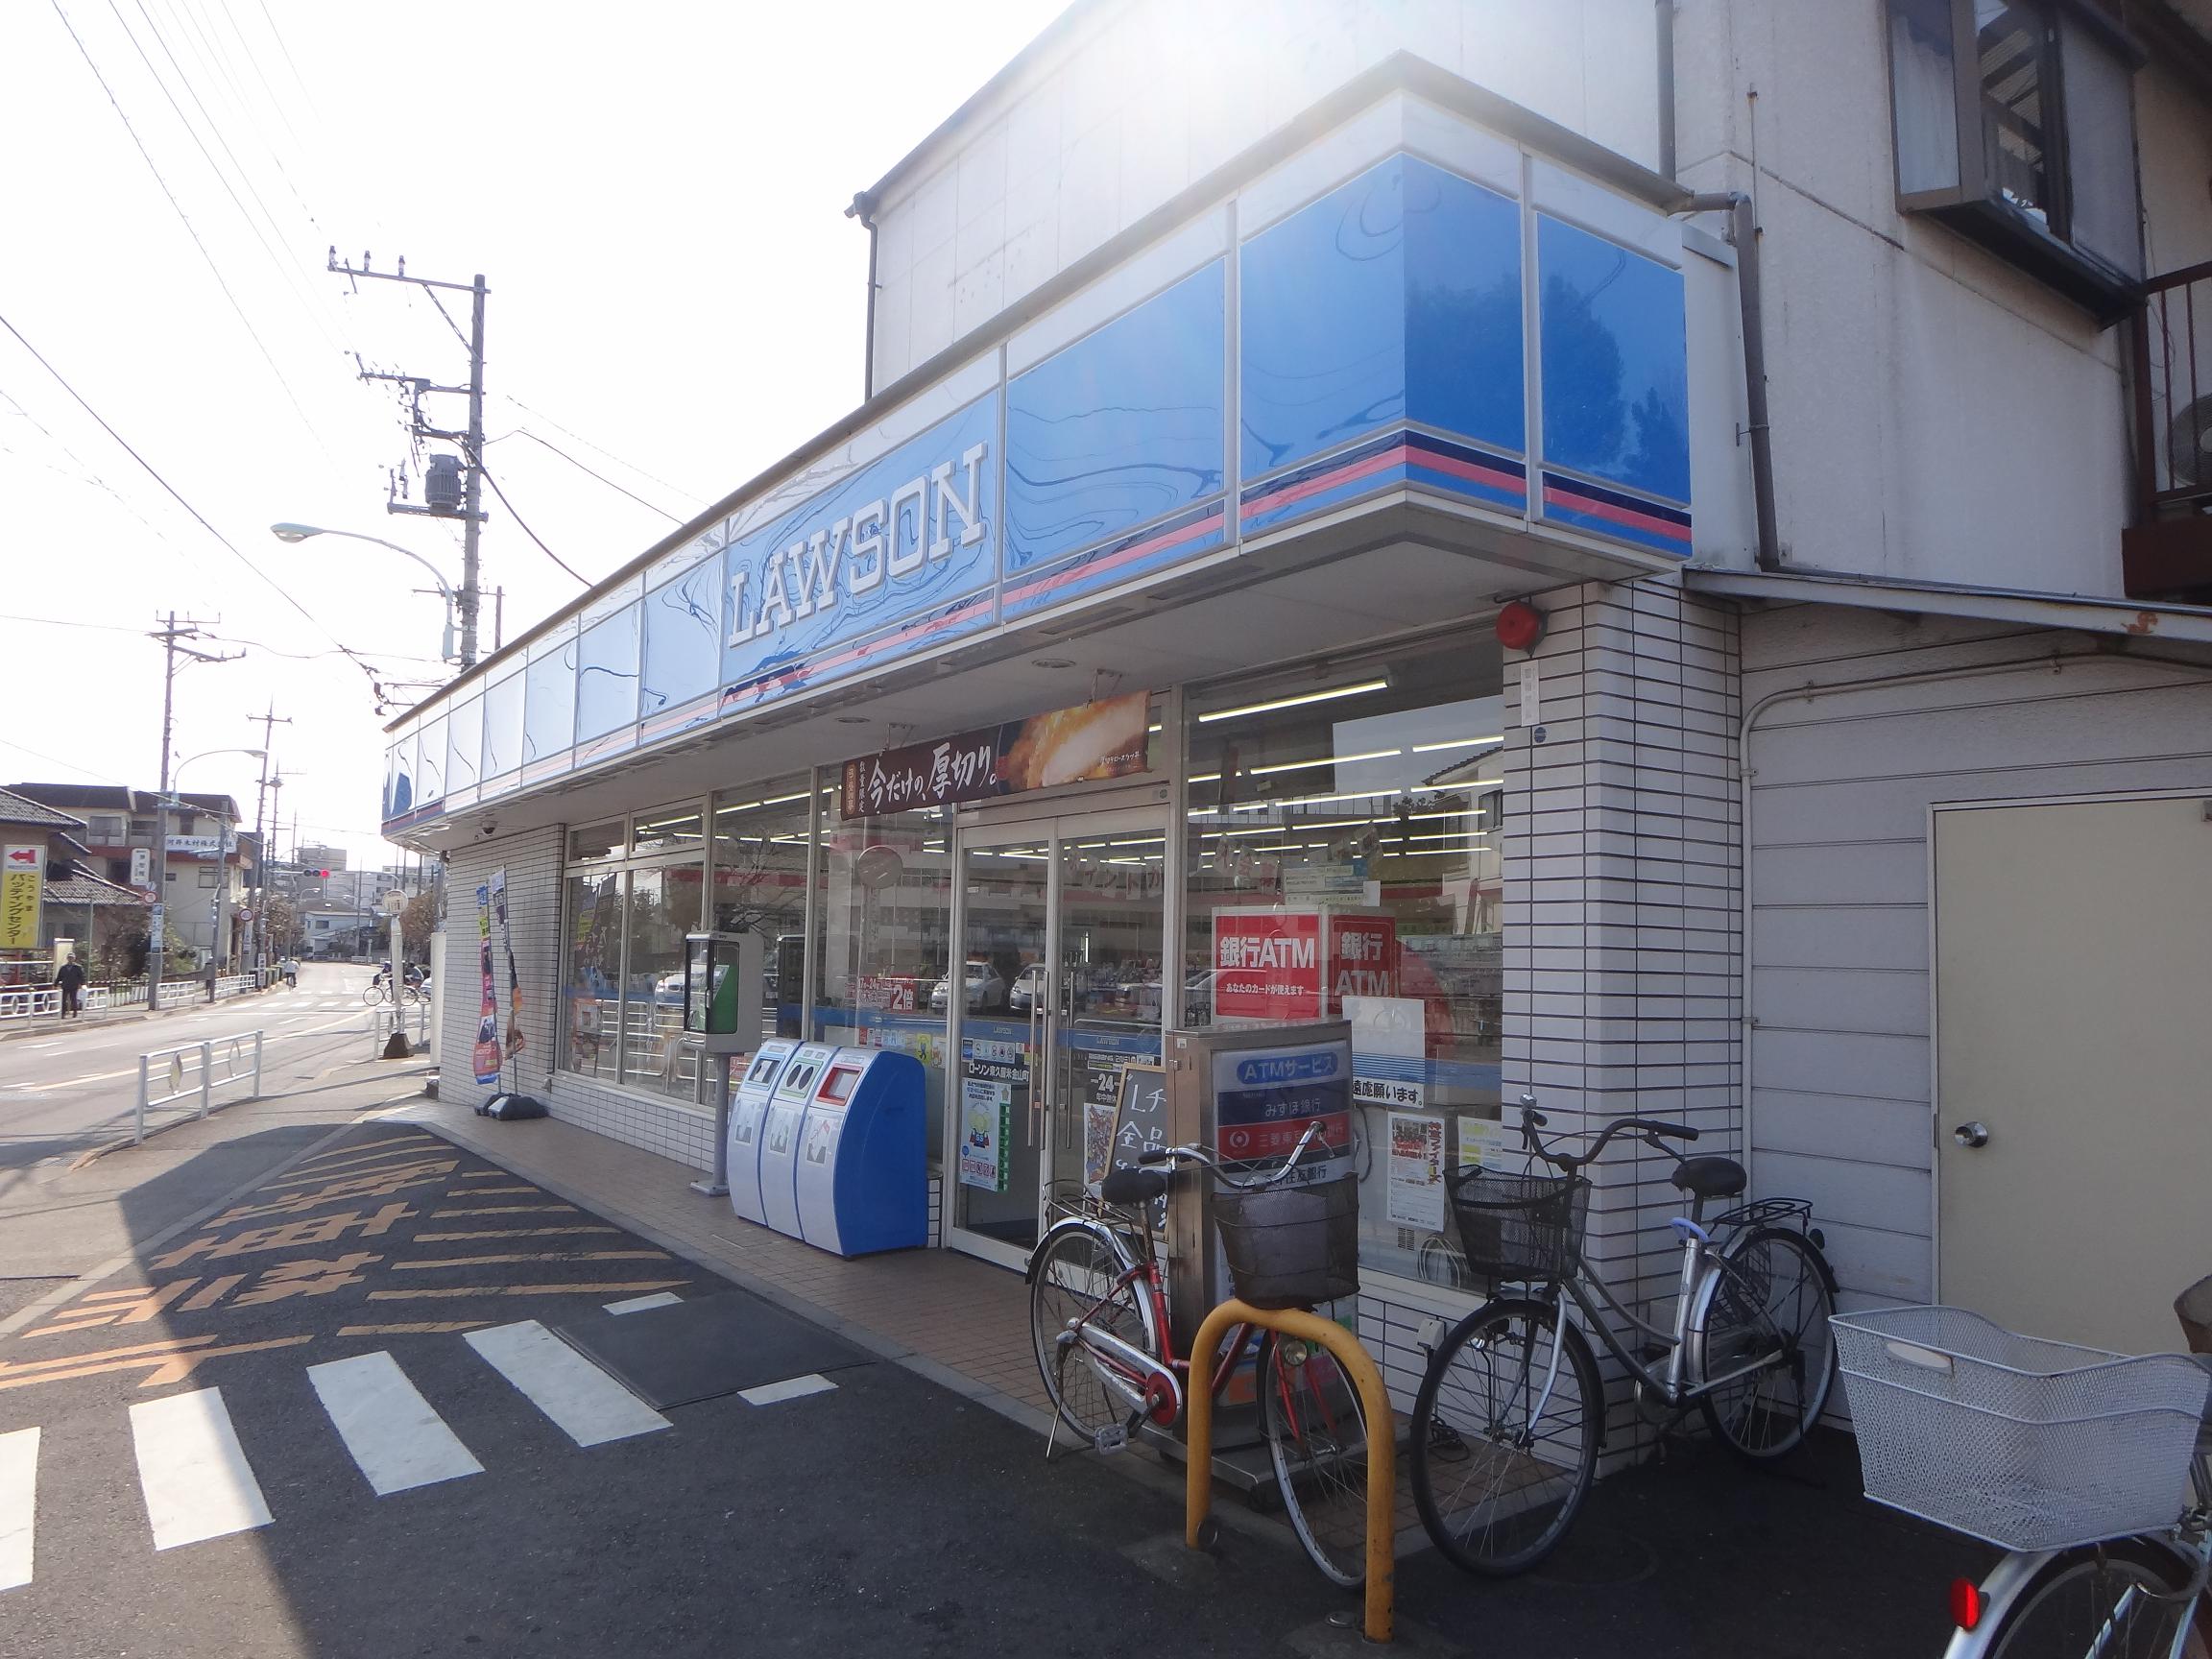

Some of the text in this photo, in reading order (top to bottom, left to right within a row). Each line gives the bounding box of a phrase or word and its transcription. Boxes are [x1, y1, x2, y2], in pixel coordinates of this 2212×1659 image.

[729, 440, 988, 649] LAWSON
[867, 742, 998, 809] 今だけの、厚切り。
[7, 874, 26, 946] バッティングセンター
[1219, 936, 1315, 969] 銀行ATM
[1340, 931, 1383, 961] 銀行
[1225, 982, 1305, 996] あなたのカードが使えます
[1334, 970, 1390, 997] ATM
[892, 984, 914, 1011] 2倍
[1244, 1055, 1334, 1081] ATMサービス
[1352, 1080, 1423, 1106] 遠慮願います。
[1264, 1097, 1321, 1118] みずほ銀行
[1117, 1120, 1167, 1152] 全品
[1265, 1164, 1327, 1187] 住友銀行
